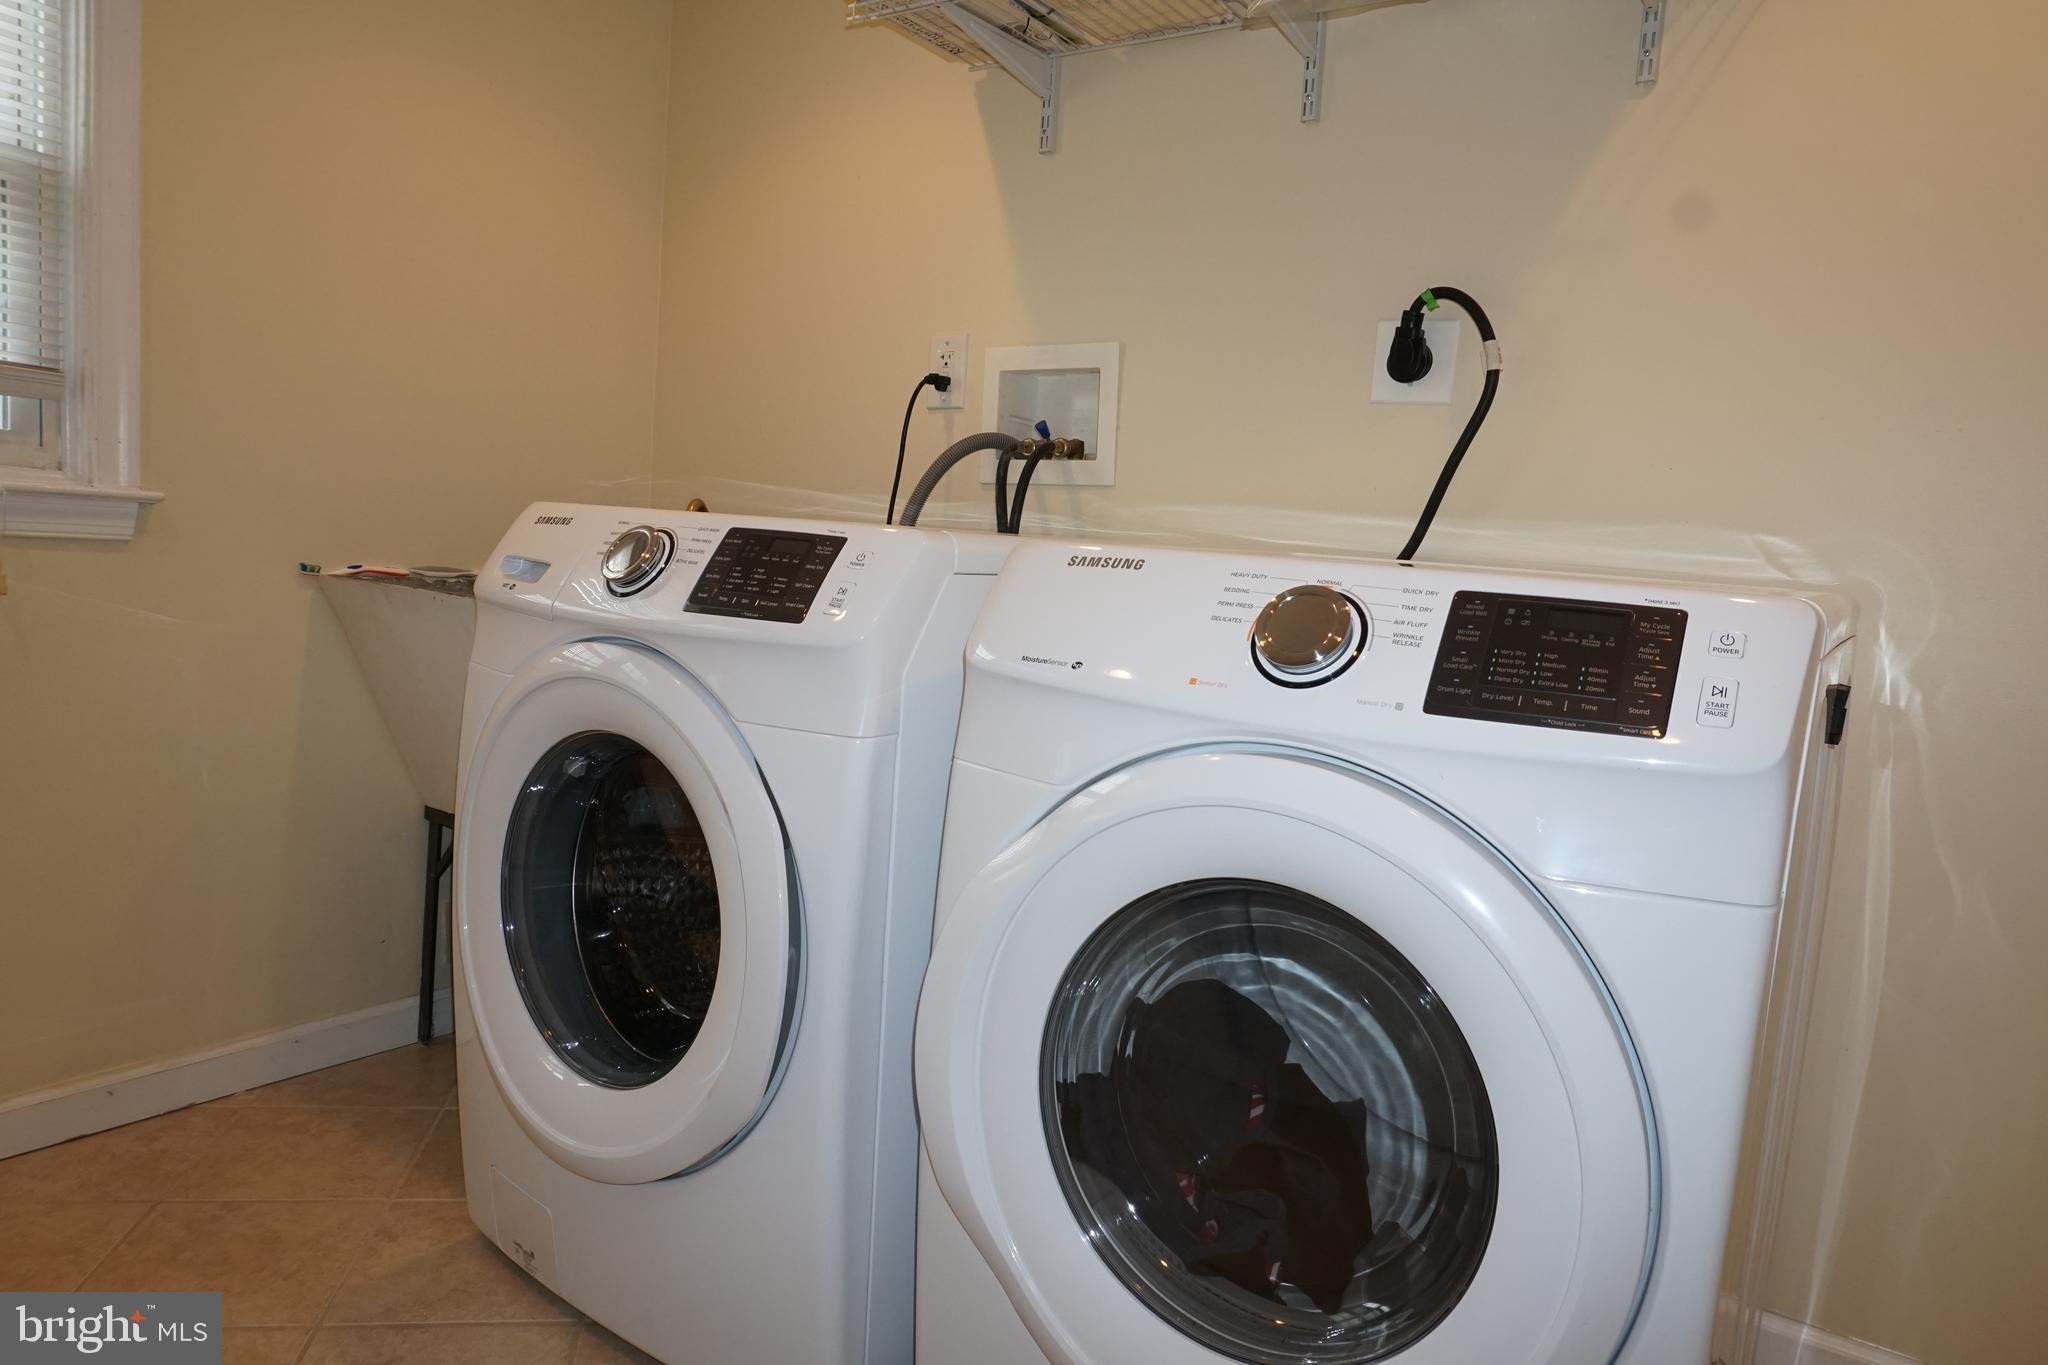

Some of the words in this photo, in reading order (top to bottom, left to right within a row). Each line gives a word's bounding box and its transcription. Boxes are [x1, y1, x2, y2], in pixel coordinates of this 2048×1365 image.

[534, 516, 574, 526] SAMSUNG
[1067, 555, 1146, 571] SAMSUNG
[1316, 579, 1343, 587] NORMAL
[1223, 586, 1251, 594] BEDDING
[1402, 587, 1424, 595] QUICK
[1235, 601, 1254, 609] PRESS
[1401, 604, 1419, 612] TIME
[1210, 615, 1242, 624] DELICATES
[1406, 621, 1429, 629] FLUFF
[1640, 621, 1651, 630] My
[1652, 622, 1671, 630] Cycle
[1457, 628, 1481, 636] Wrinkle
[1392, 632, 1424, 641] WRINKLE
[1391, 639, 1422, 648] RELEASE
[1638, 646, 1661, 655] Adjust
[1712, 646, 1740, 655] POWER
[1637, 652, 1654, 660] Time
[1021, 655, 1068, 667] MoistureSensor
[1541, 661, 1567, 669] Medium
[1519, 668, 1530, 676] Dry
[1494, 675, 1512, 683] Damp
[1587, 676, 1607, 684] 40min
[1634, 674, 1656, 683] Adjust
[1633, 681, 1650, 689] Time
[1455, 686, 1472, 695] Light
[1482, 692, 1495, 700] Dry
[1495, 693, 1514, 701] Level
[1533, 698, 1553, 706] Temp.
[1705, 701, 1730, 709] START
[1581, 703, 1598, 711] Time
[1628, 707, 1650, 716] Sound
[1703, 709, 1728, 718] PAUSE
